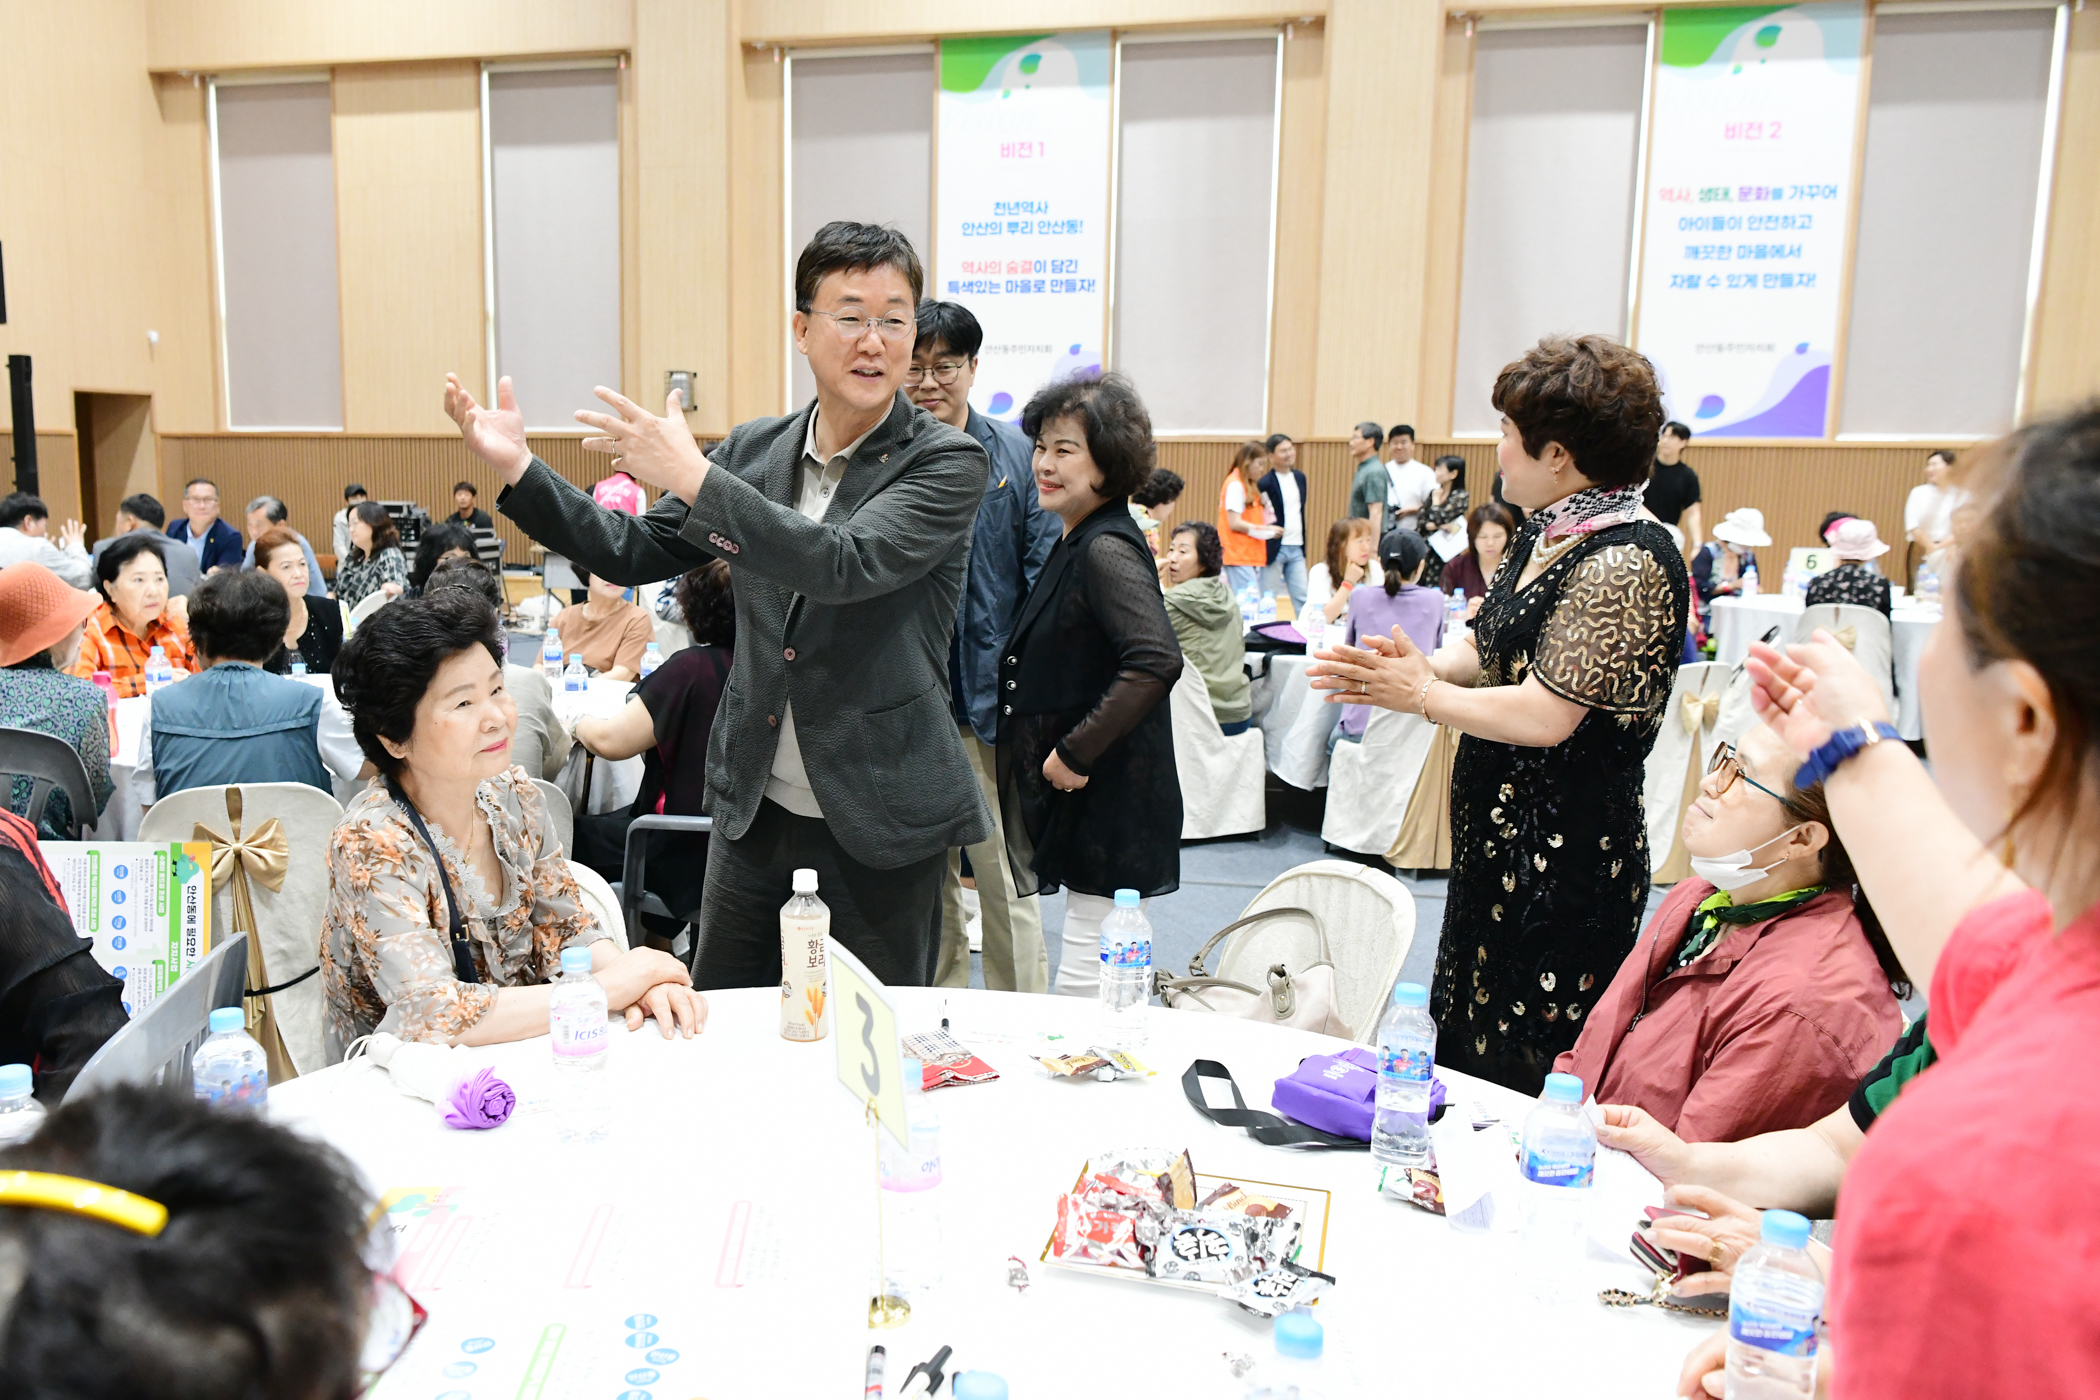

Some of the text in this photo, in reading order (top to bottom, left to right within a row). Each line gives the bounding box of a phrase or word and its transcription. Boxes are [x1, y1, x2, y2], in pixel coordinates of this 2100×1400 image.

[1723, 121, 1782, 140] 비전 2
[1000, 141, 1045, 159] 비전 1
[1788, 184, 1838, 200] 가꾸어
[993, 201, 1049, 216] 천년역사
[962, 219, 1083, 236] 안산의 뿌리 안산동!
[1678, 214, 1813, 232] 아이들이 안전하고
[1684, 243, 1802, 261] 깨끗한 마을에서
[961, 259, 1078, 275] 역사의 숨결이 담긴
[947, 278, 1096, 295] 특색있는 마을로 만들자!
[1669, 272, 1817, 289] 자랄 수 있게 만들자!
[1805, 554, 1818, 570] 6
[186, 885, 197, 925] 안산동에
[186, 927, 197, 957] 필요한
[170, 941, 179, 972] 자치사업
[574, 1028, 598, 1041] ICIS
[855, 991, 881, 1097] 3
